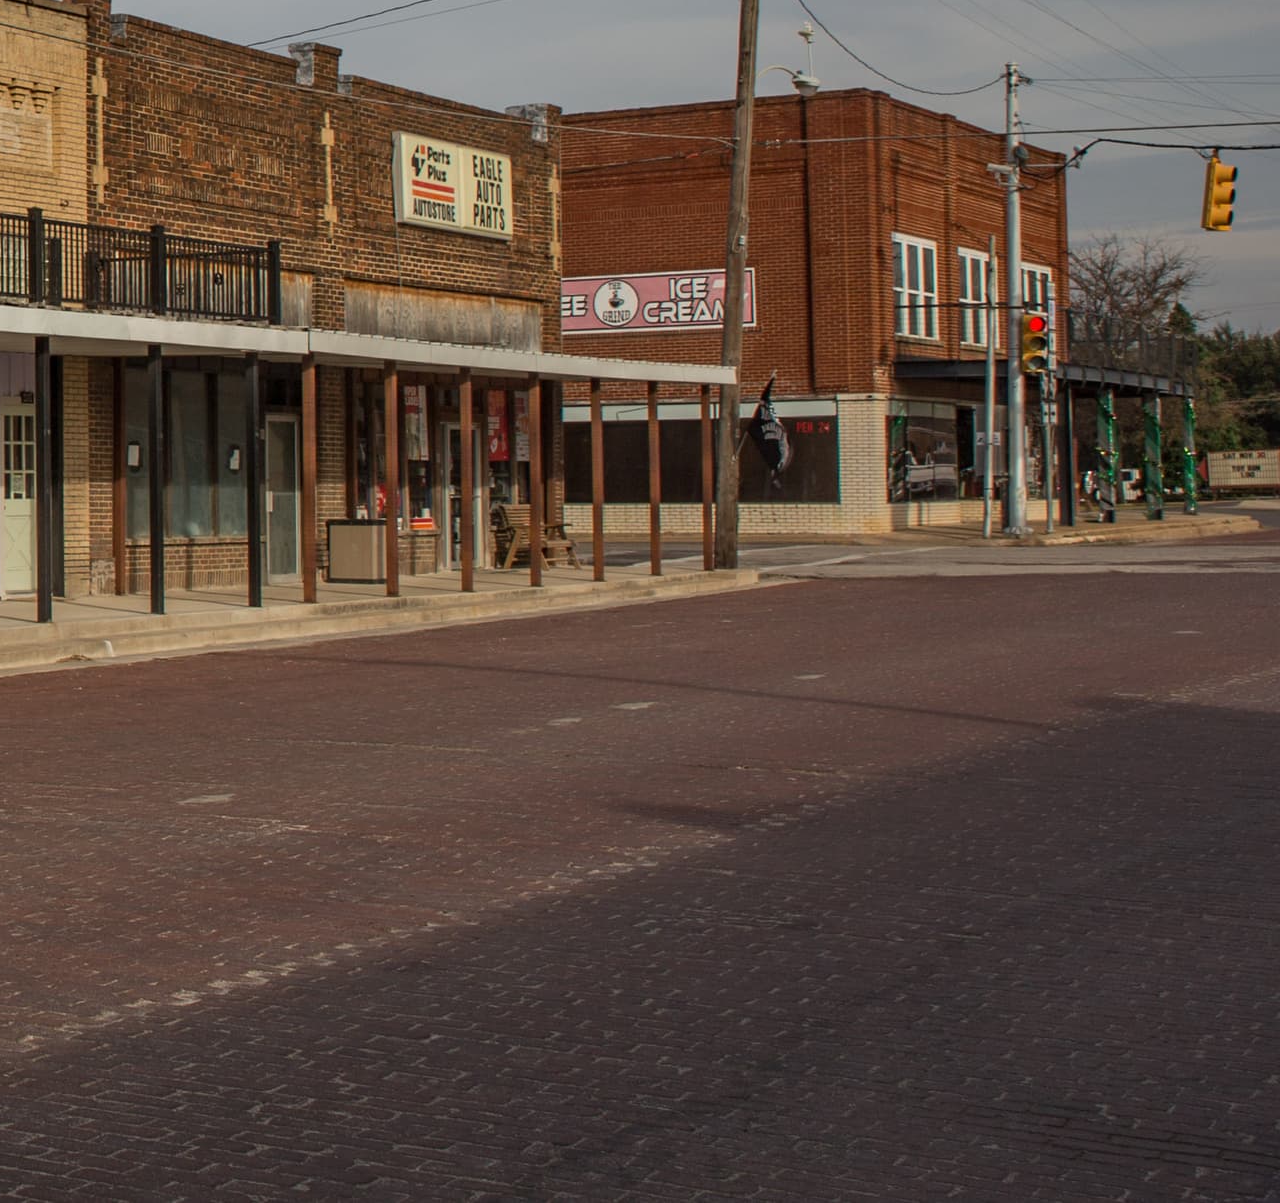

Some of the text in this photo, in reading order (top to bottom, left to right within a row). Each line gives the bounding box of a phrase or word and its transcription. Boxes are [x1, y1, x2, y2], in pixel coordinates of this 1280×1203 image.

[427, 147, 451, 165] Parts
[427, 164, 447, 182] Plus
[472, 154, 503, 183] EAGLE
[476, 180, 502, 206] AUTO
[413, 198, 456, 223] AUTOSTORE
[473, 204, 505, 231] PARTS
[669, 277, 707, 300] ICE
[602, 309, 631, 323] GRIND
